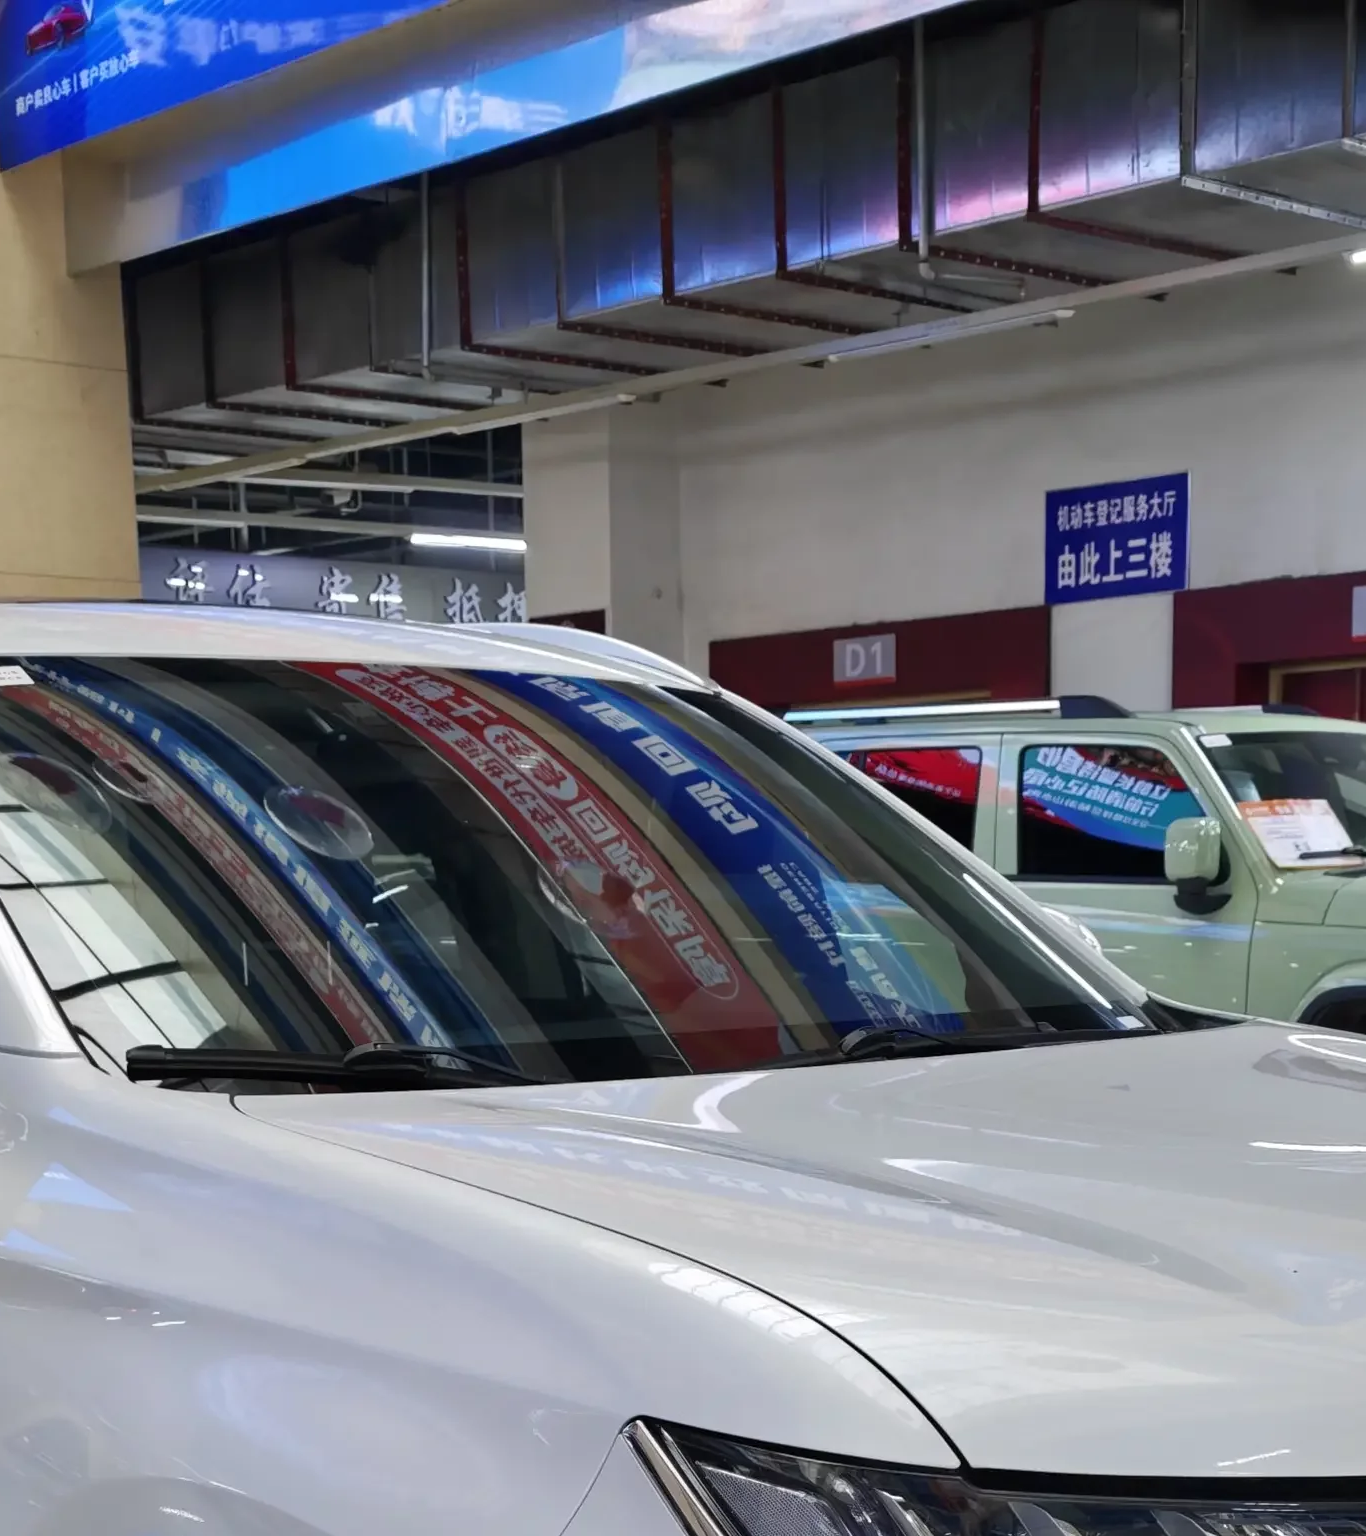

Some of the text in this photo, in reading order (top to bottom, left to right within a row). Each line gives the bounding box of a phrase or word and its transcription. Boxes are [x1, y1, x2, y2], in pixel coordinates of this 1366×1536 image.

[1057, 491, 1176, 532] 机动车登记服务大厅
[1058, 530, 1173, 589] 由此上三楼
[846, 642, 882, 677] D1
